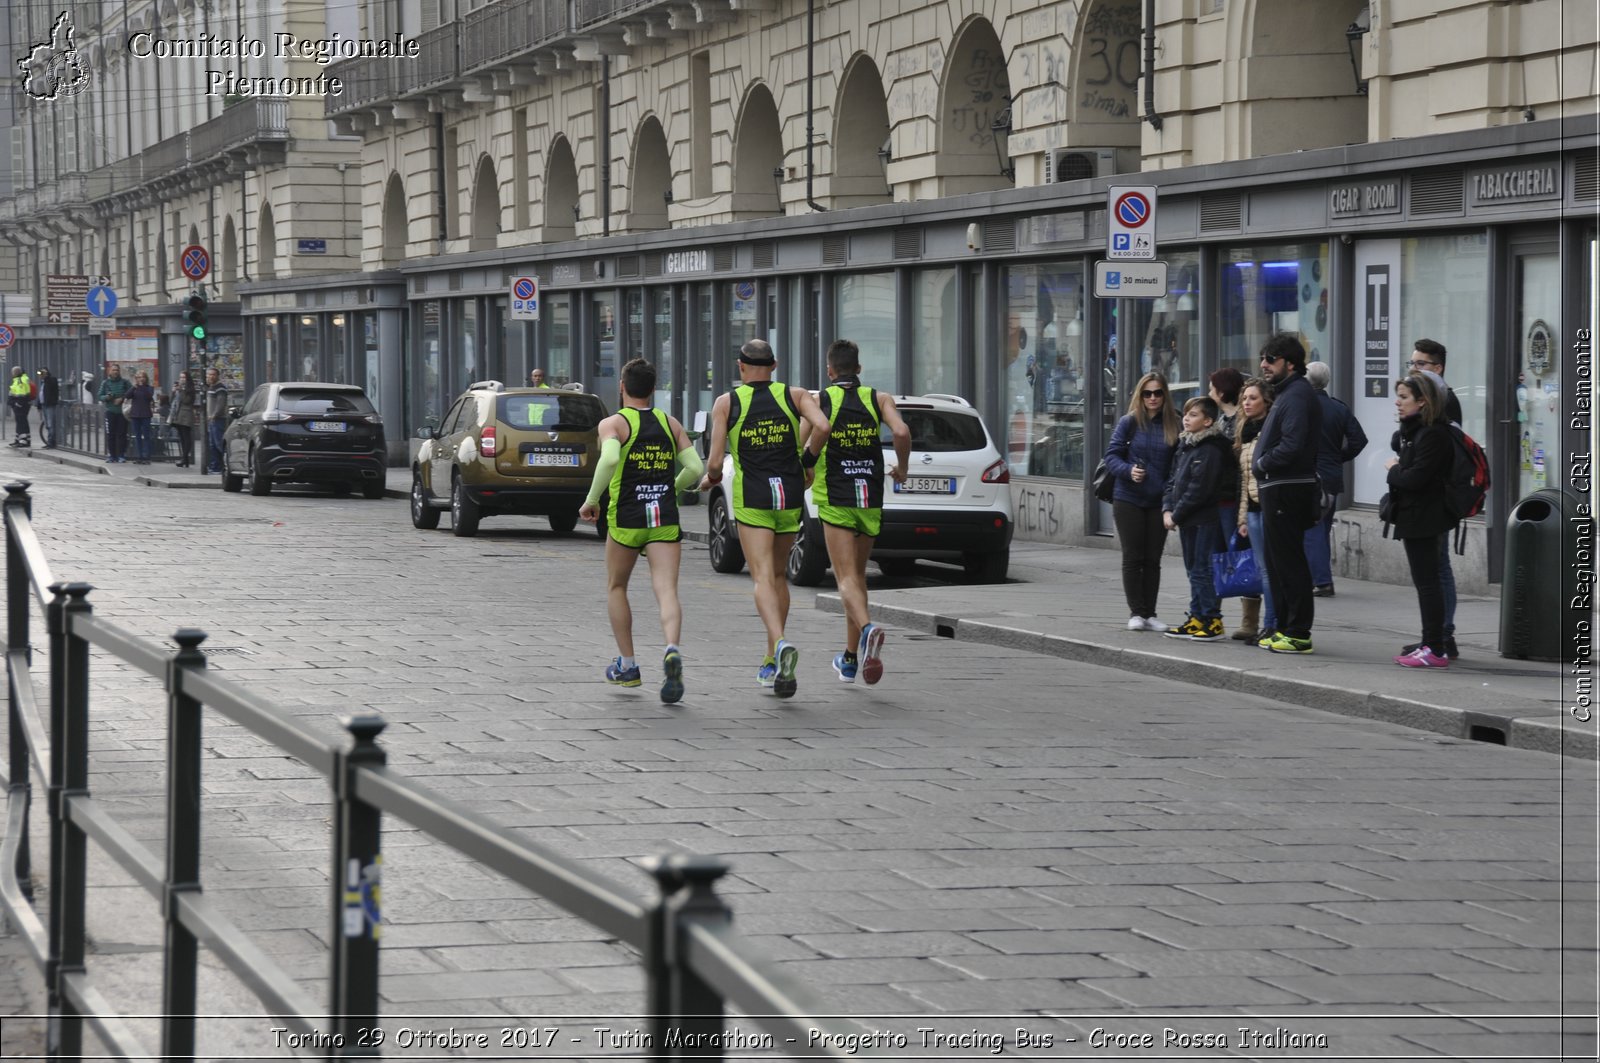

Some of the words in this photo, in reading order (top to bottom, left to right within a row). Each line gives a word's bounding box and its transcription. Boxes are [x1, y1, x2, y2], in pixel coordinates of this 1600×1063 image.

[1473, 168, 1555, 199] TABACCHERIA
[1331, 187, 1360, 212] CIGAR
[1366, 184, 1396, 208] ROOM
[668, 250, 707, 272] GELATERIA
[1123, 276, 1133, 284] 30
[1134, 277, 1158, 285] minuti
[768, 424, 790, 434] PAURA
[534, 454, 545, 464] FE
[841, 459, 875, 467] ATLETA
[917, 479, 949, 491] 587LM
[1018, 488, 1059, 537] ACAB
